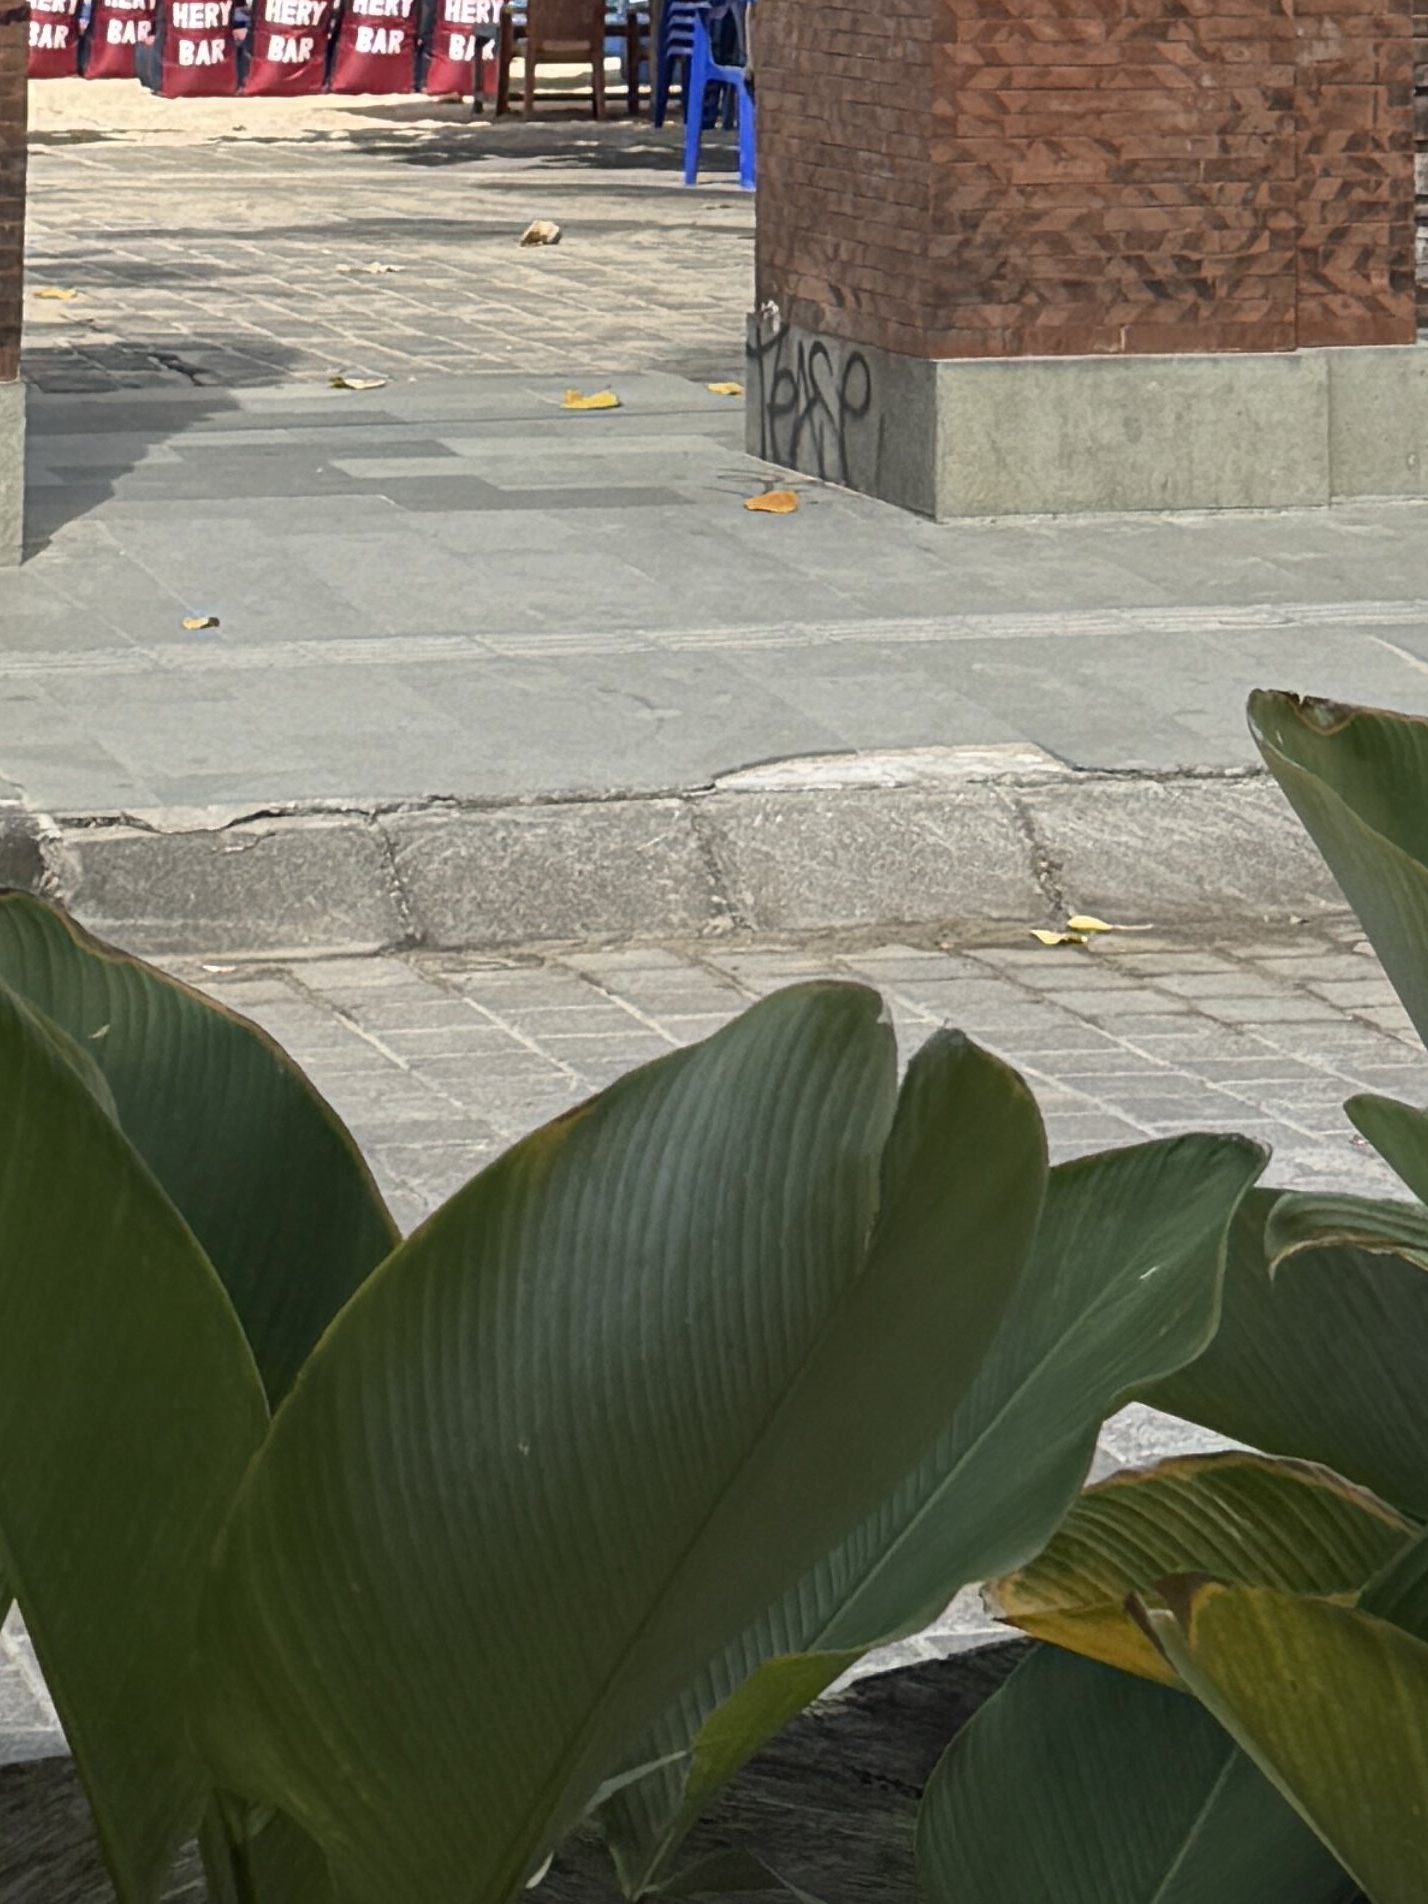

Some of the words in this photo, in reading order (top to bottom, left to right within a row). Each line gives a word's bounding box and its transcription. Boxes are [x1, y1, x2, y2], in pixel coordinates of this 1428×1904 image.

[172, 0, 233, 29] HERY
[106, 18, 152, 45] BAR
[355, 26, 405, 54] BAR
[179, 38, 226, 66] BAR
[267, 34, 314, 64] BAR
